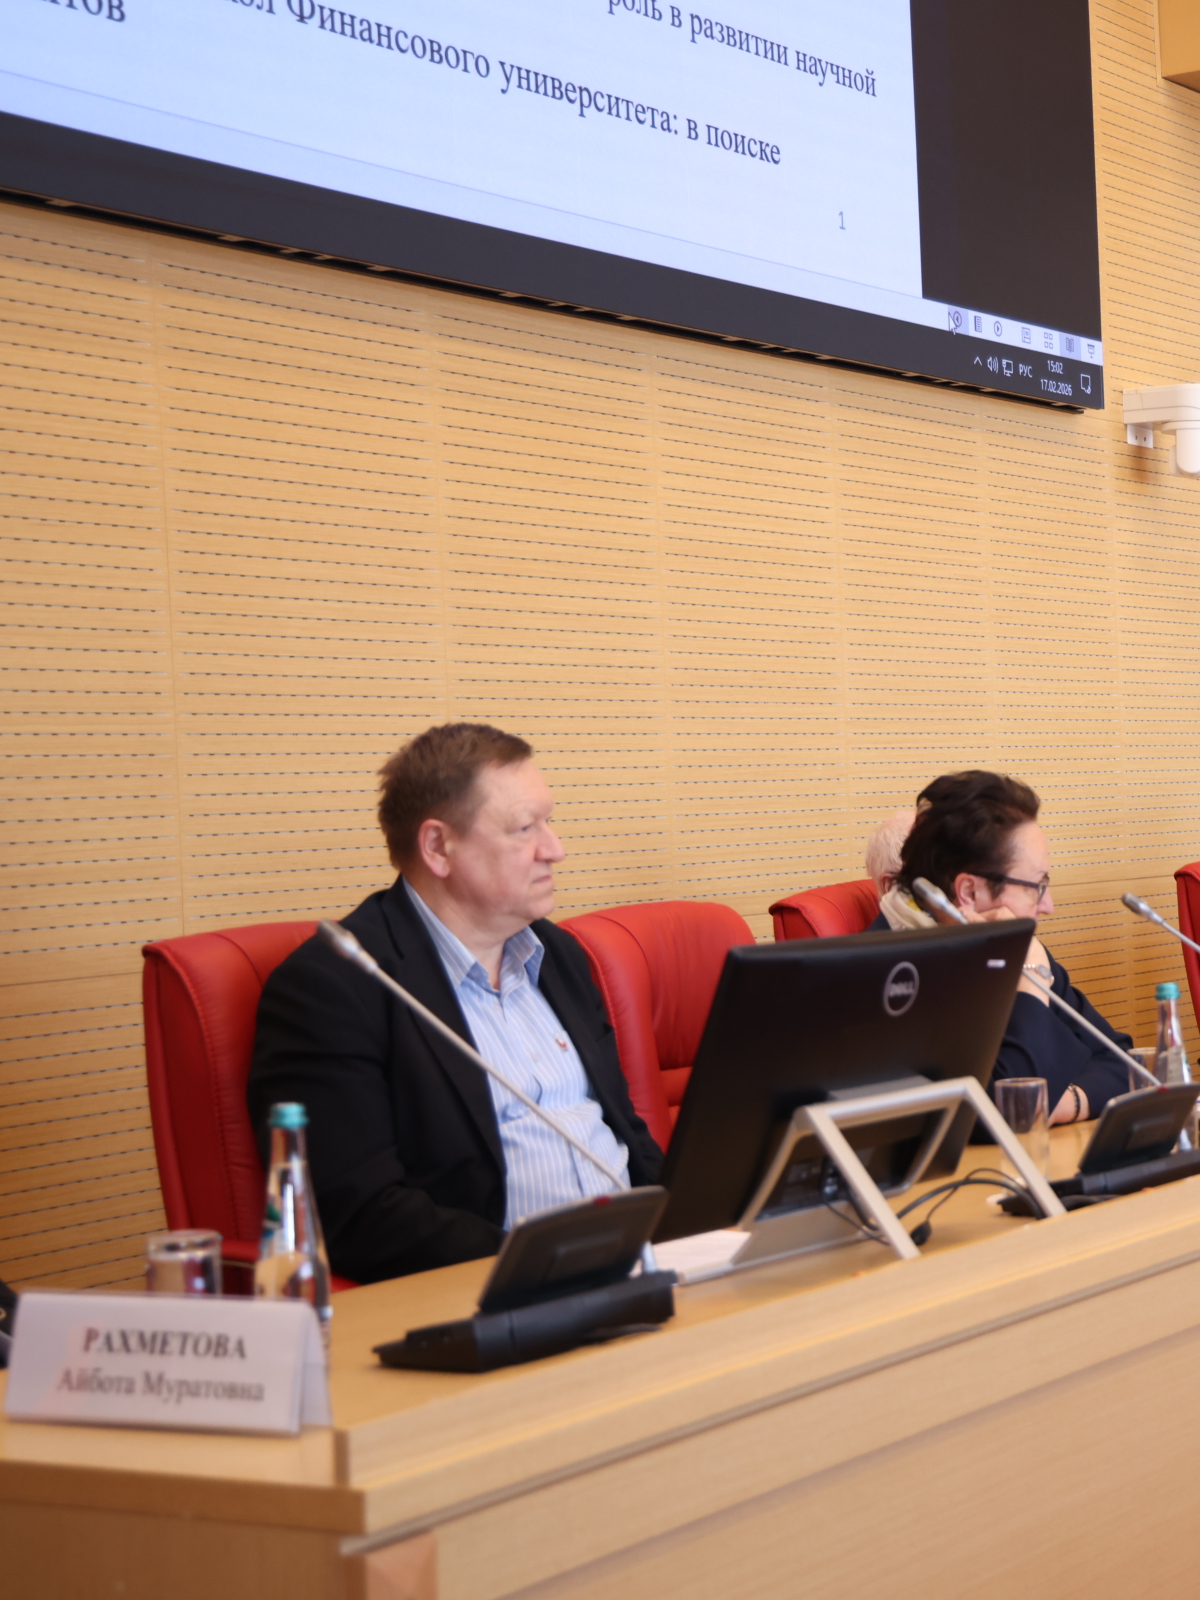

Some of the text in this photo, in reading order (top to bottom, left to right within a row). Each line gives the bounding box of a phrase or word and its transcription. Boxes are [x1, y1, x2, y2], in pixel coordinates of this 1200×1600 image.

[670, 4, 682, 28] в
[689, 12, 789, 66] развитии
[795, 50, 877, 98] научной
[287, 0, 781, 165] Финансового университета: в поиске
[838, 211, 846, 230] 1
[1018, 364, 1032, 378] РУС
[1047, 360, 1064, 374] 15:02
[82, 1327, 248, 1360] РАХМЕТОВА
[56, 1367, 265, 1405] Айбота Муратовна
